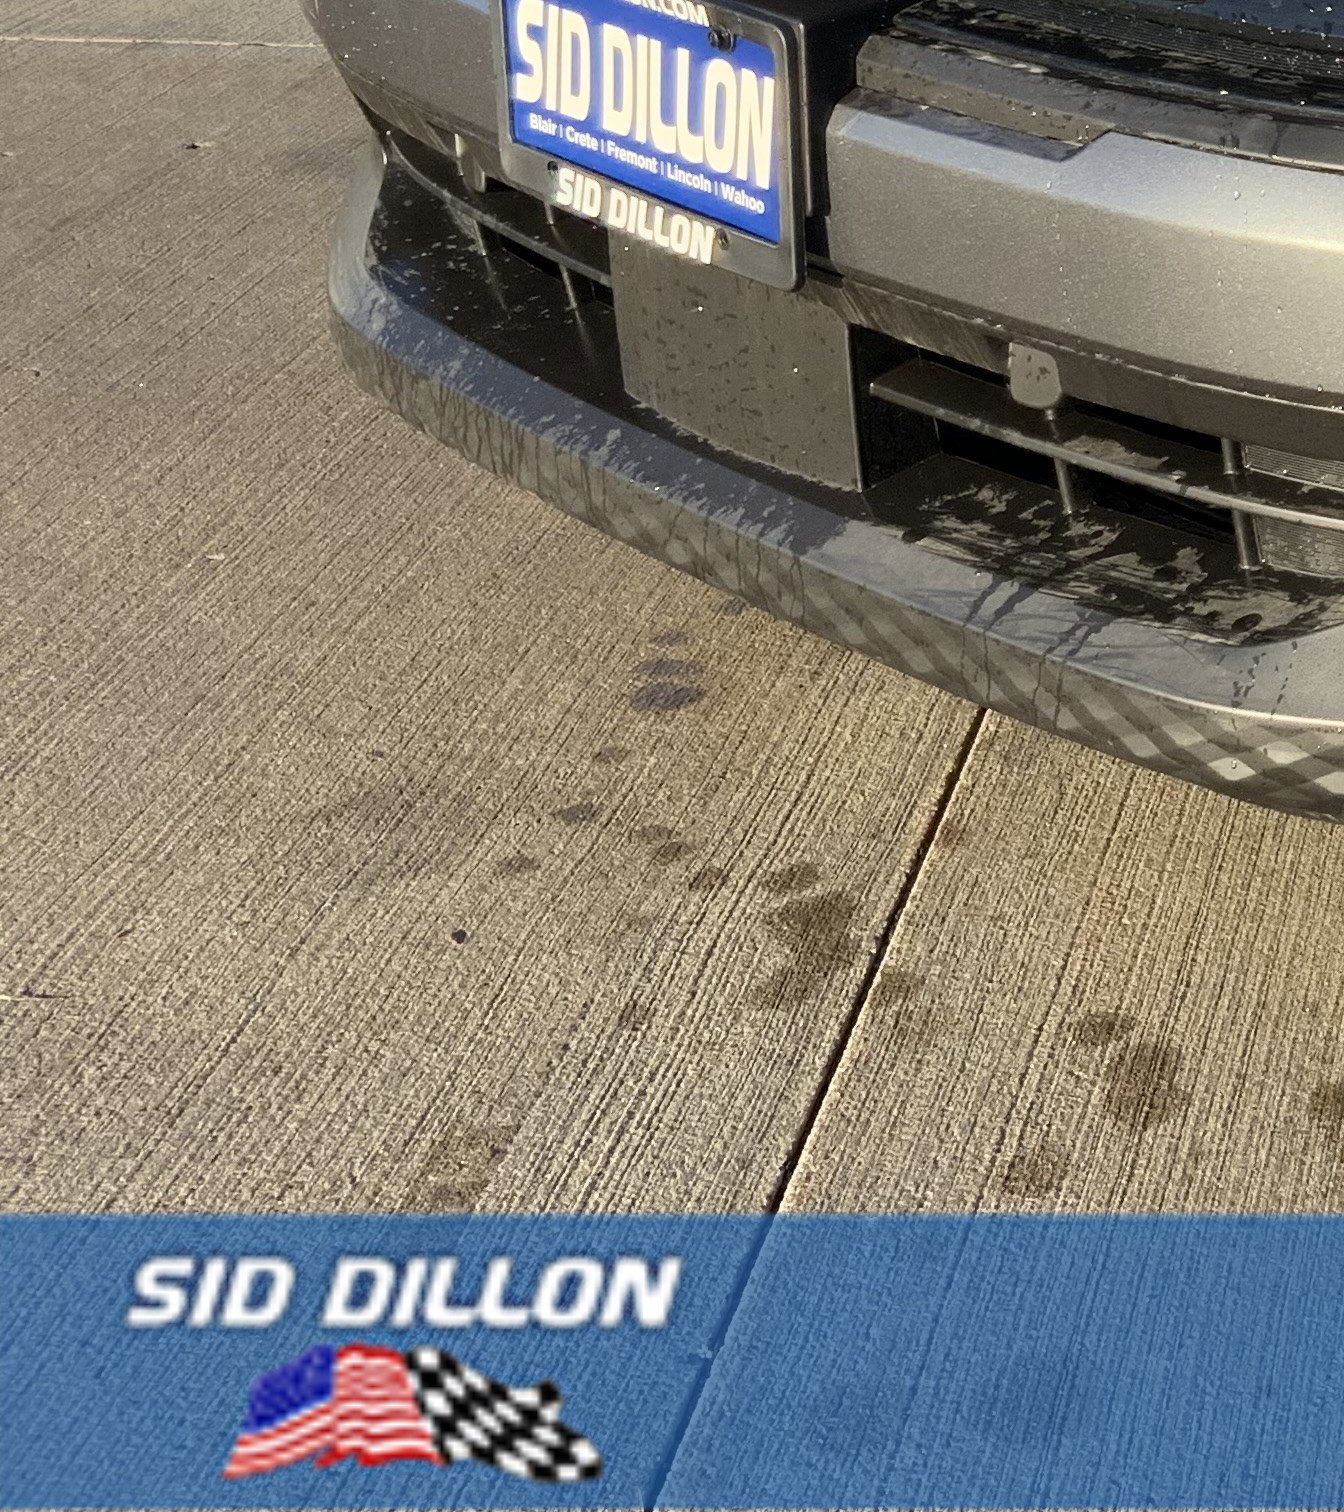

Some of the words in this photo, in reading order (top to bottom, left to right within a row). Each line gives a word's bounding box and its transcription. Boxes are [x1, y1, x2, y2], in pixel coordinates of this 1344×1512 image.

[602, 22, 776, 191] DILLON
[529, 113, 558, 139] Blair
[565, 126, 599, 153] Crete
[606, 141, 659, 175] Fremont
[667, 163, 713, 195] Lincoln
[721, 183, 766, 216] Wahoo
[555, 167, 603, 219] SID
[608, 187, 717, 265] DILLON
